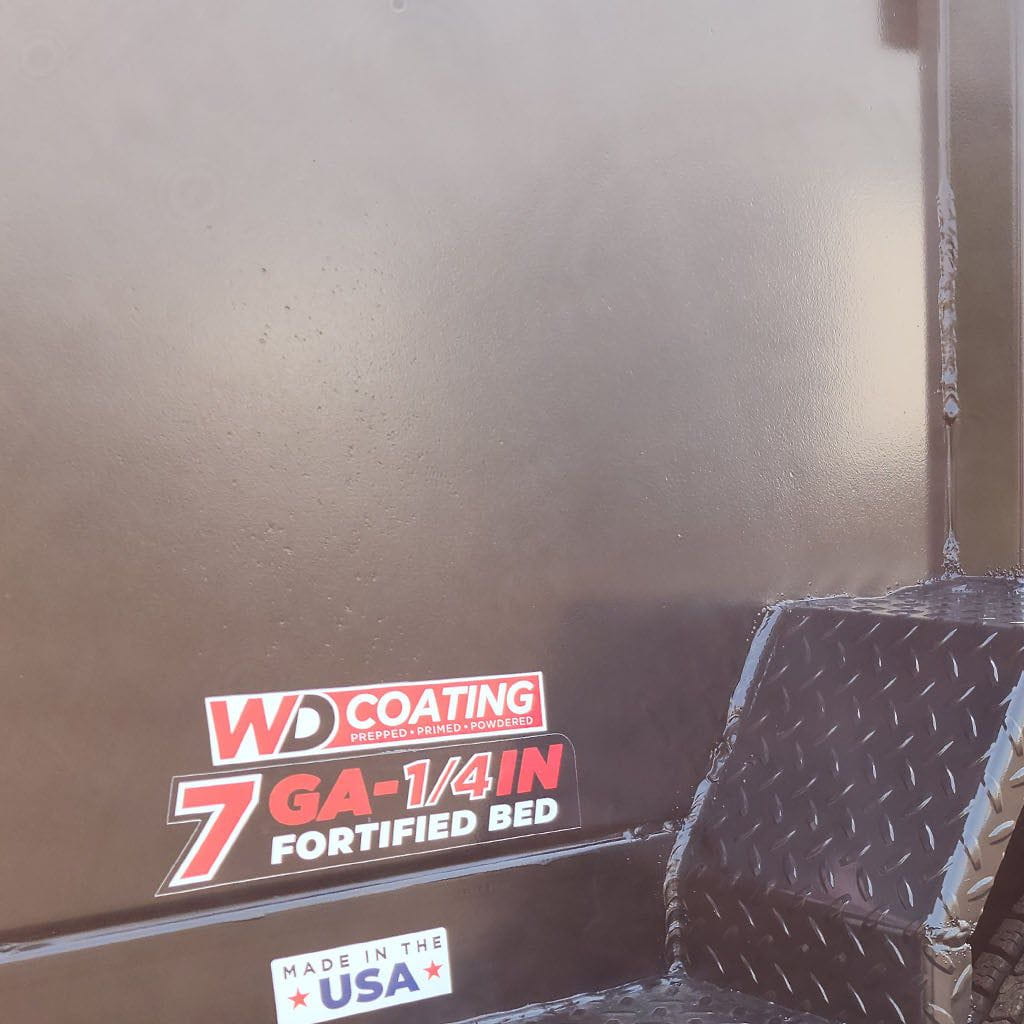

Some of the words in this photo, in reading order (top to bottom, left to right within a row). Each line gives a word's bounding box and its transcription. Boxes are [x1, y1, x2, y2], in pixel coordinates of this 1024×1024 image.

[210, 694, 336, 761] WD
[346, 680, 534, 730] COATING
[350, 729, 408, 743] PREPPED
[417, 723, 461, 736] PRIMED
[470, 716, 534, 730] POWDERED
[168, 773, 262, 888] 7
[271, 808, 478, 866] FORTIFIED
[487, 797, 559, 832] BED
[283, 954, 351, 980] MADE
[364, 946, 388, 964] IN
[401, 935, 443, 956] THE
[319, 961, 421, 1011] USA
